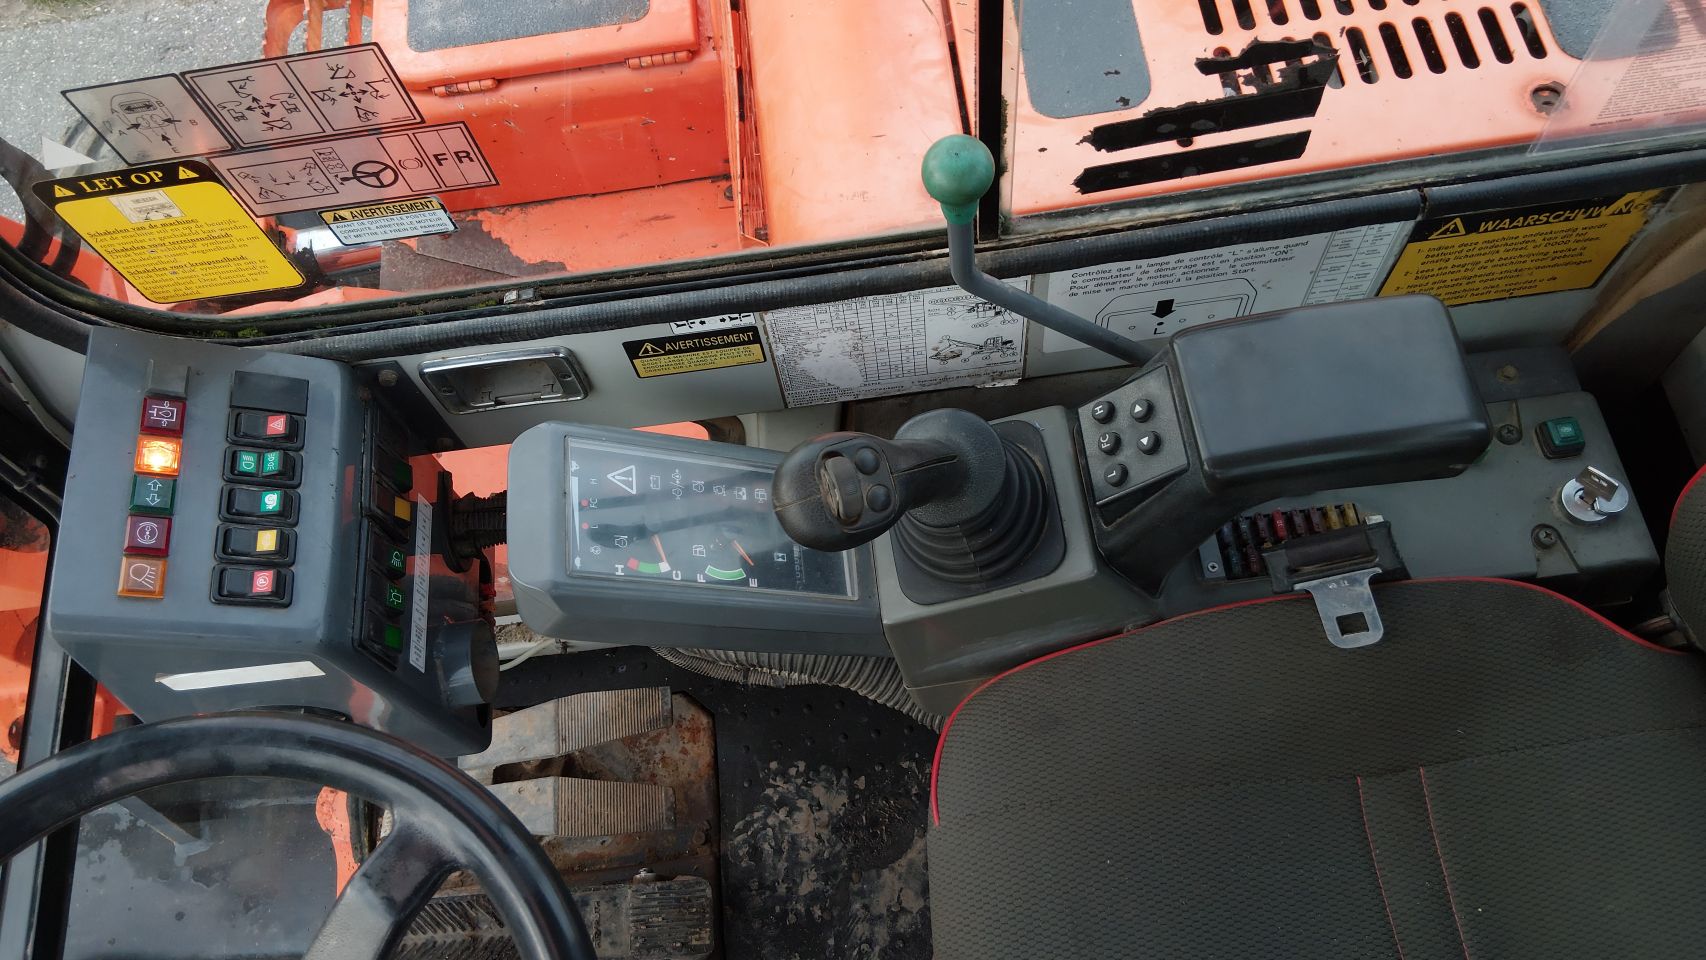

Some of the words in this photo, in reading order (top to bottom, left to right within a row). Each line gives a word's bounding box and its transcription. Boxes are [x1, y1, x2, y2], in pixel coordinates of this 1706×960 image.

[432, 153, 448, 167] F
[454, 149, 474, 164] R
[78, 176, 128, 192] LET
[130, 170, 163, 185] OP
[350, 200, 436, 220] AVERTISSEMENT
[1479, 203, 1645, 232] WAARSCHUWNG
[1072, 269, 1112, 278] Contrôlez
[1189, 253, 1223, 262] contrôle
[1247, 245, 1279, 254] s'allume
[1284, 241, 1309, 249] quand
[1082, 272, 1135, 283] commutateur
[1154, 263, 1197, 273] démarrage
[1233, 254, 1266, 263] position
[1094, 279, 1131, 288] démarrer
[1181, 267, 1220, 275] actionnez
[1240, 256, 1295, 267] commutateur
[1152, 278, 1180, 288] jusqu'à
[1196, 272, 1227, 281] position
[665, 332, 754, 352] AVERTISSEMENT
[1094, 405, 1104, 415] H
[1100, 434, 1111, 449] FC
[1108, 470, 1116, 478] L
[590, 497, 598, 508] FC
[615, 564, 624, 576] H
[672, 570, 682, 581] C
[697, 574, 706, 583] F
[750, 578, 758, 587] E
